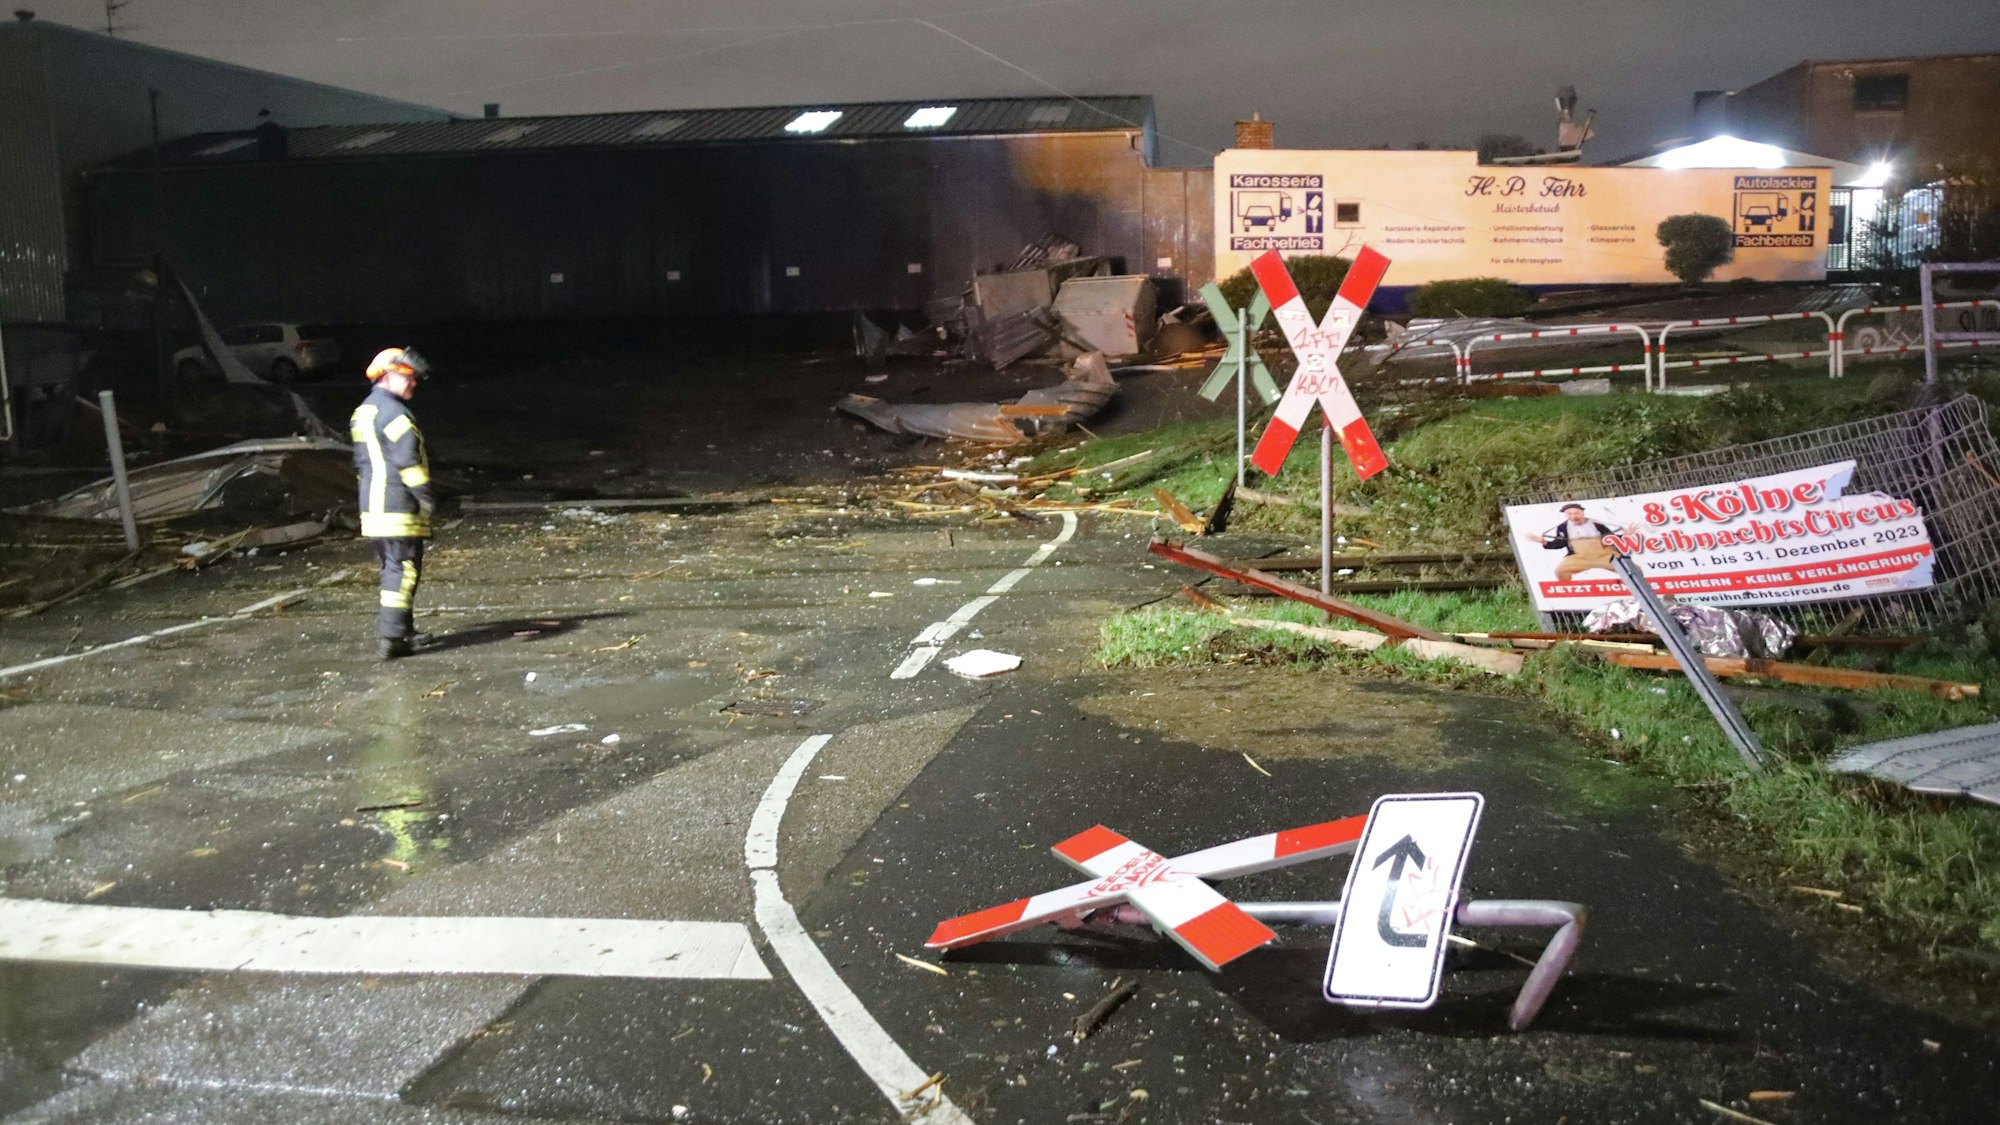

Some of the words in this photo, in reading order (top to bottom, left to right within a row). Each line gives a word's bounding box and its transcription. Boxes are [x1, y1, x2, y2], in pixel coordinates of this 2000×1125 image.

[1233, 175, 1321, 187] Karosserie
[1540, 176, 1587, 197] Fehr
[1737, 177, 1815, 188] Autolackier
[1492, 203, 1560, 213] Meisterbetrieb
[1234, 237, 1321, 249] Fachbetrieb
[1736, 235, 1811, 246] Fachbetrieb
[1603, 498, 1917, 554] WeihnachtsCircus
[1647, 560, 1684, 570] vom
[1691, 556, 1706, 567] 1.
[1710, 554, 1738, 565] bis
[1743, 550, 1770, 562] 31.
[1775, 536, 1867, 559] Dezember
[1873, 525, 1920, 544] 2023
[1547, 584, 1592, 594] JETZT
[1664, 577, 1732, 590] SICHERN
[1745, 572, 1793, 585] KEINE
[1796, 552, 1924, 580] VERLÄNGERUNG
